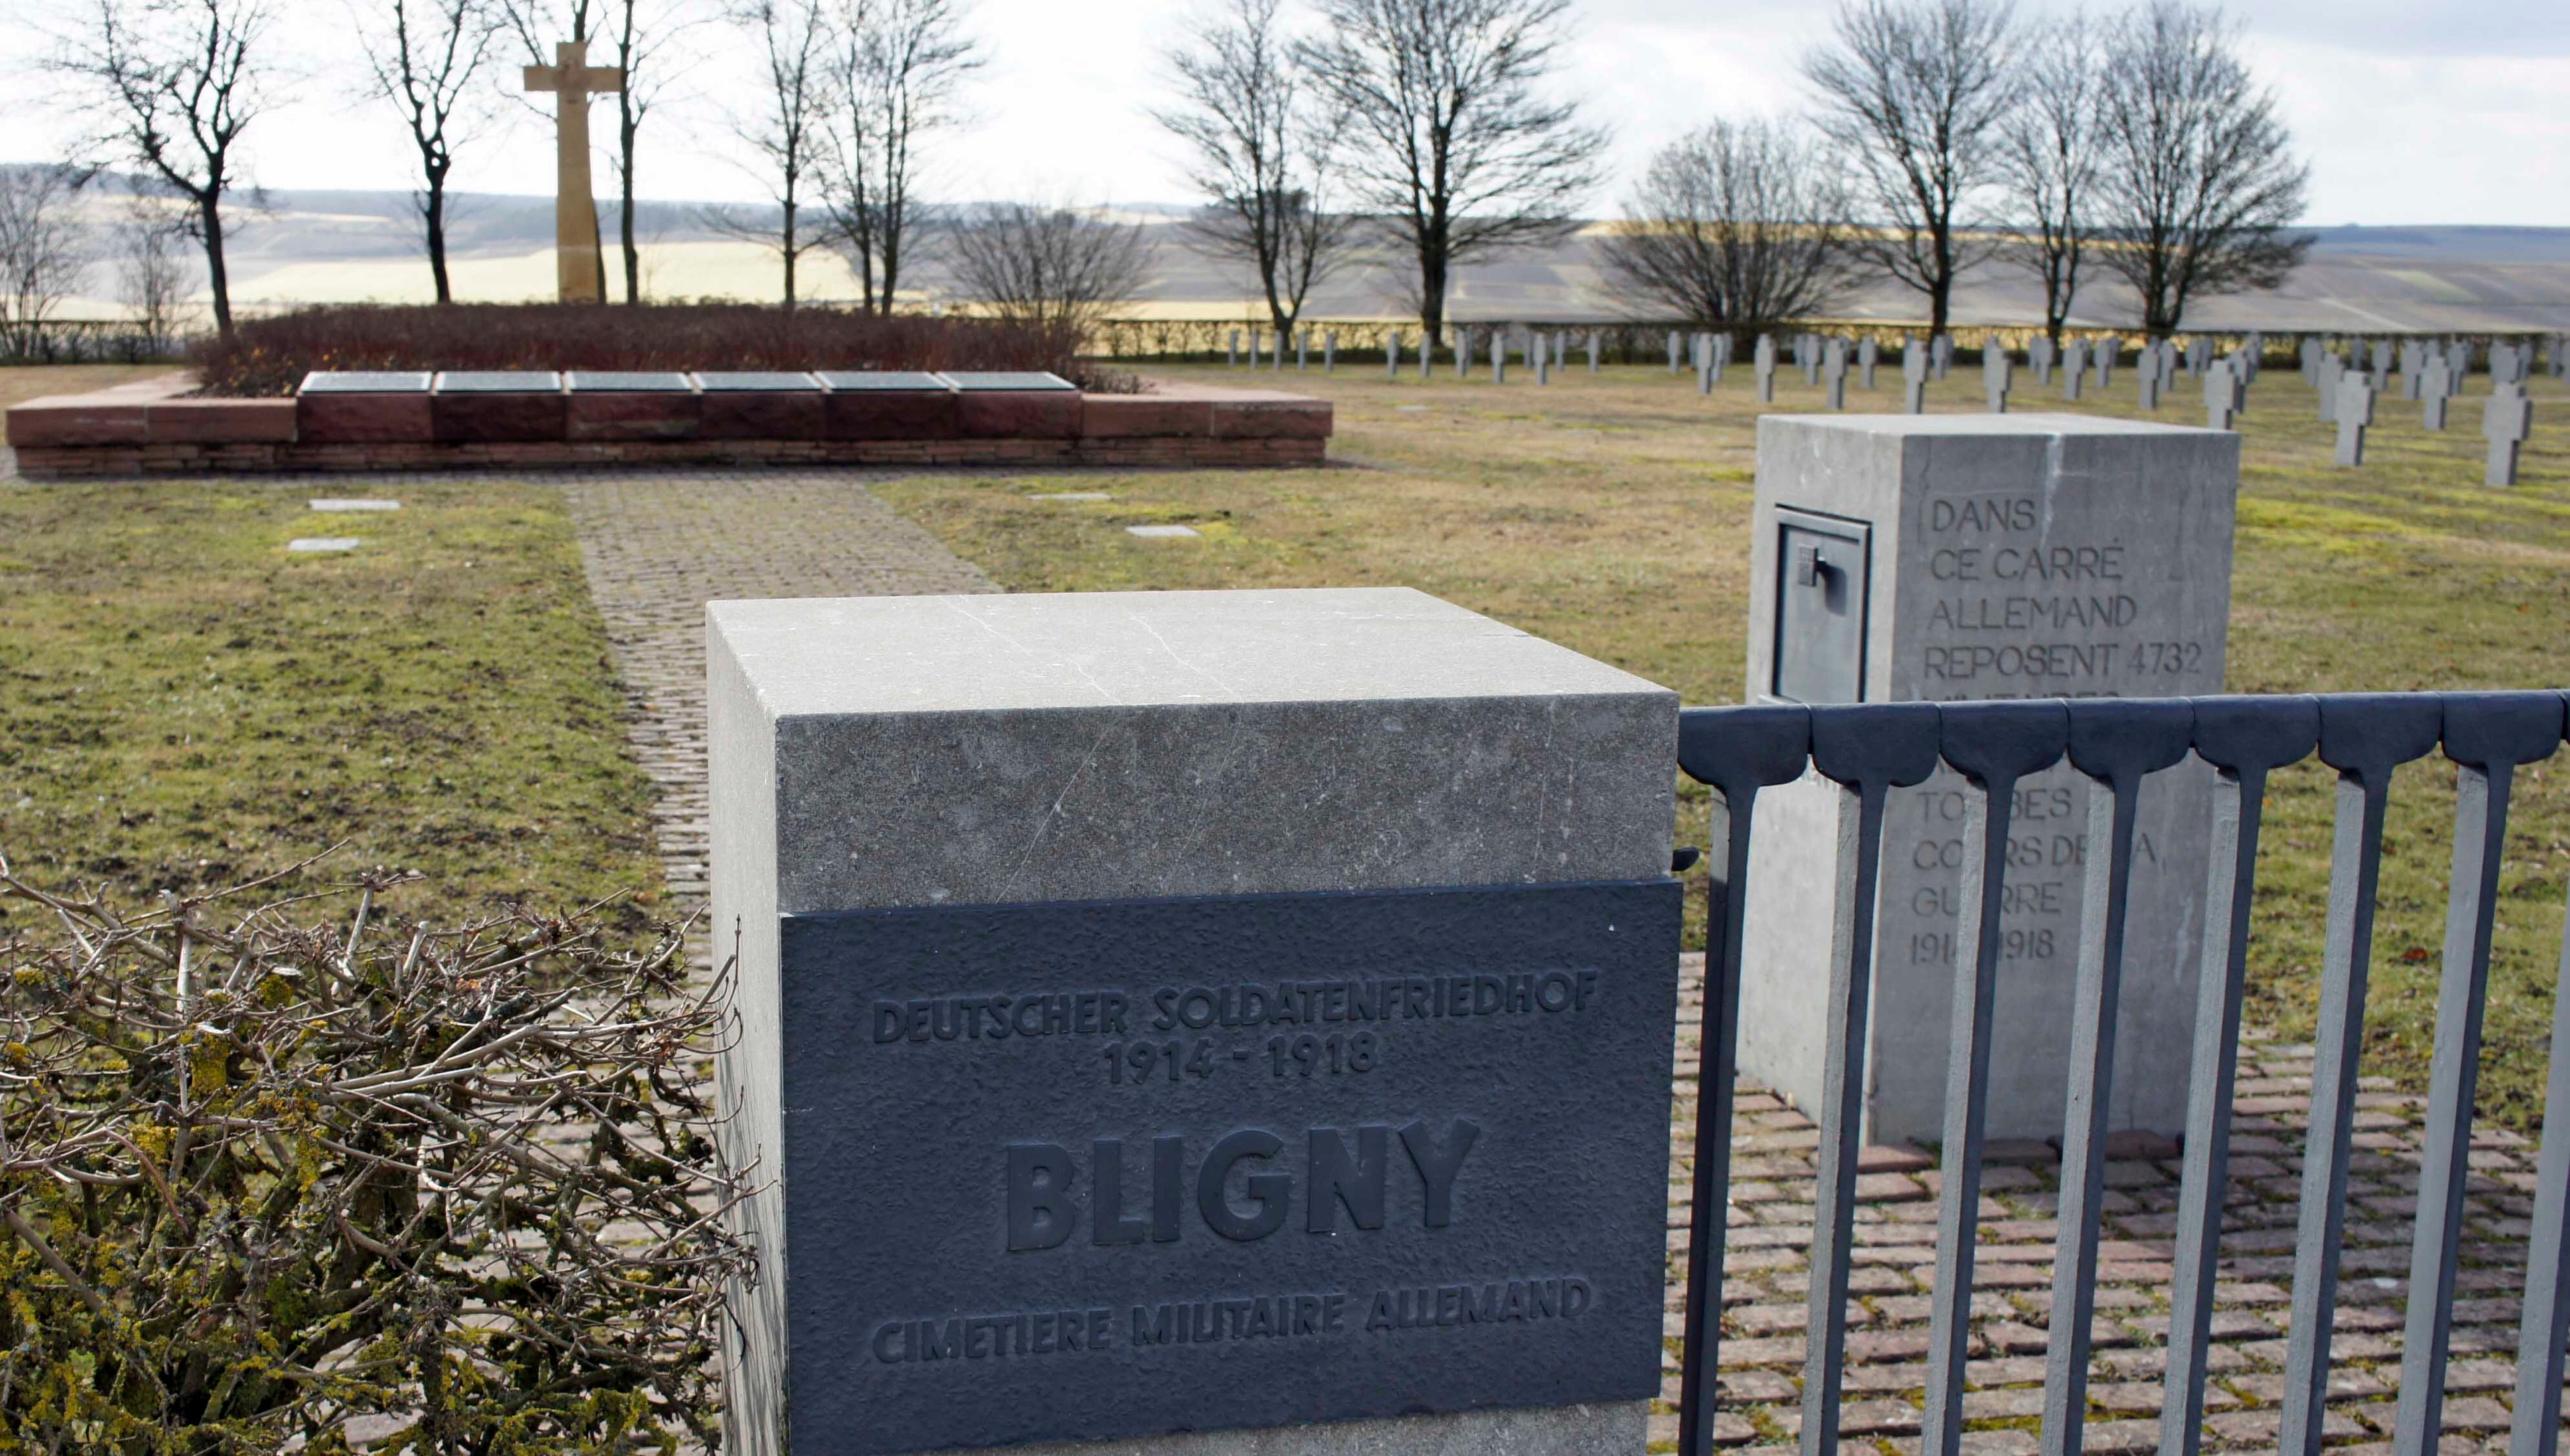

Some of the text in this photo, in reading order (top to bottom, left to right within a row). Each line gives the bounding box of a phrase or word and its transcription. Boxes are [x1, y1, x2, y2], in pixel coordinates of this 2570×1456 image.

[1932, 498, 2036, 533] DANS
[1930, 537, 2124, 581] CE CARRÉ
[1927, 594, 2138, 630] ALLEMAND
[1923, 641, 2203, 680] REPOSENT 4732
[1916, 787, 2073, 824] TOBES
[1912, 835, 2044, 871] CORS
[1911, 881, 2063, 918] GURRE
[1911, 931, 1958, 966] 191
[872, 970, 1598, 1044] DEUTSCHER SOLDATENFRIEDHOF
[1102, 1036, 1215, 1085] 1914
[1267, 1029, 1377, 1077] 1918
[1007, 1115, 1480, 1251] BLIGNY
[871, 1277, 1592, 1364] CIMETIERE MILITAIRE ALLEMAND
